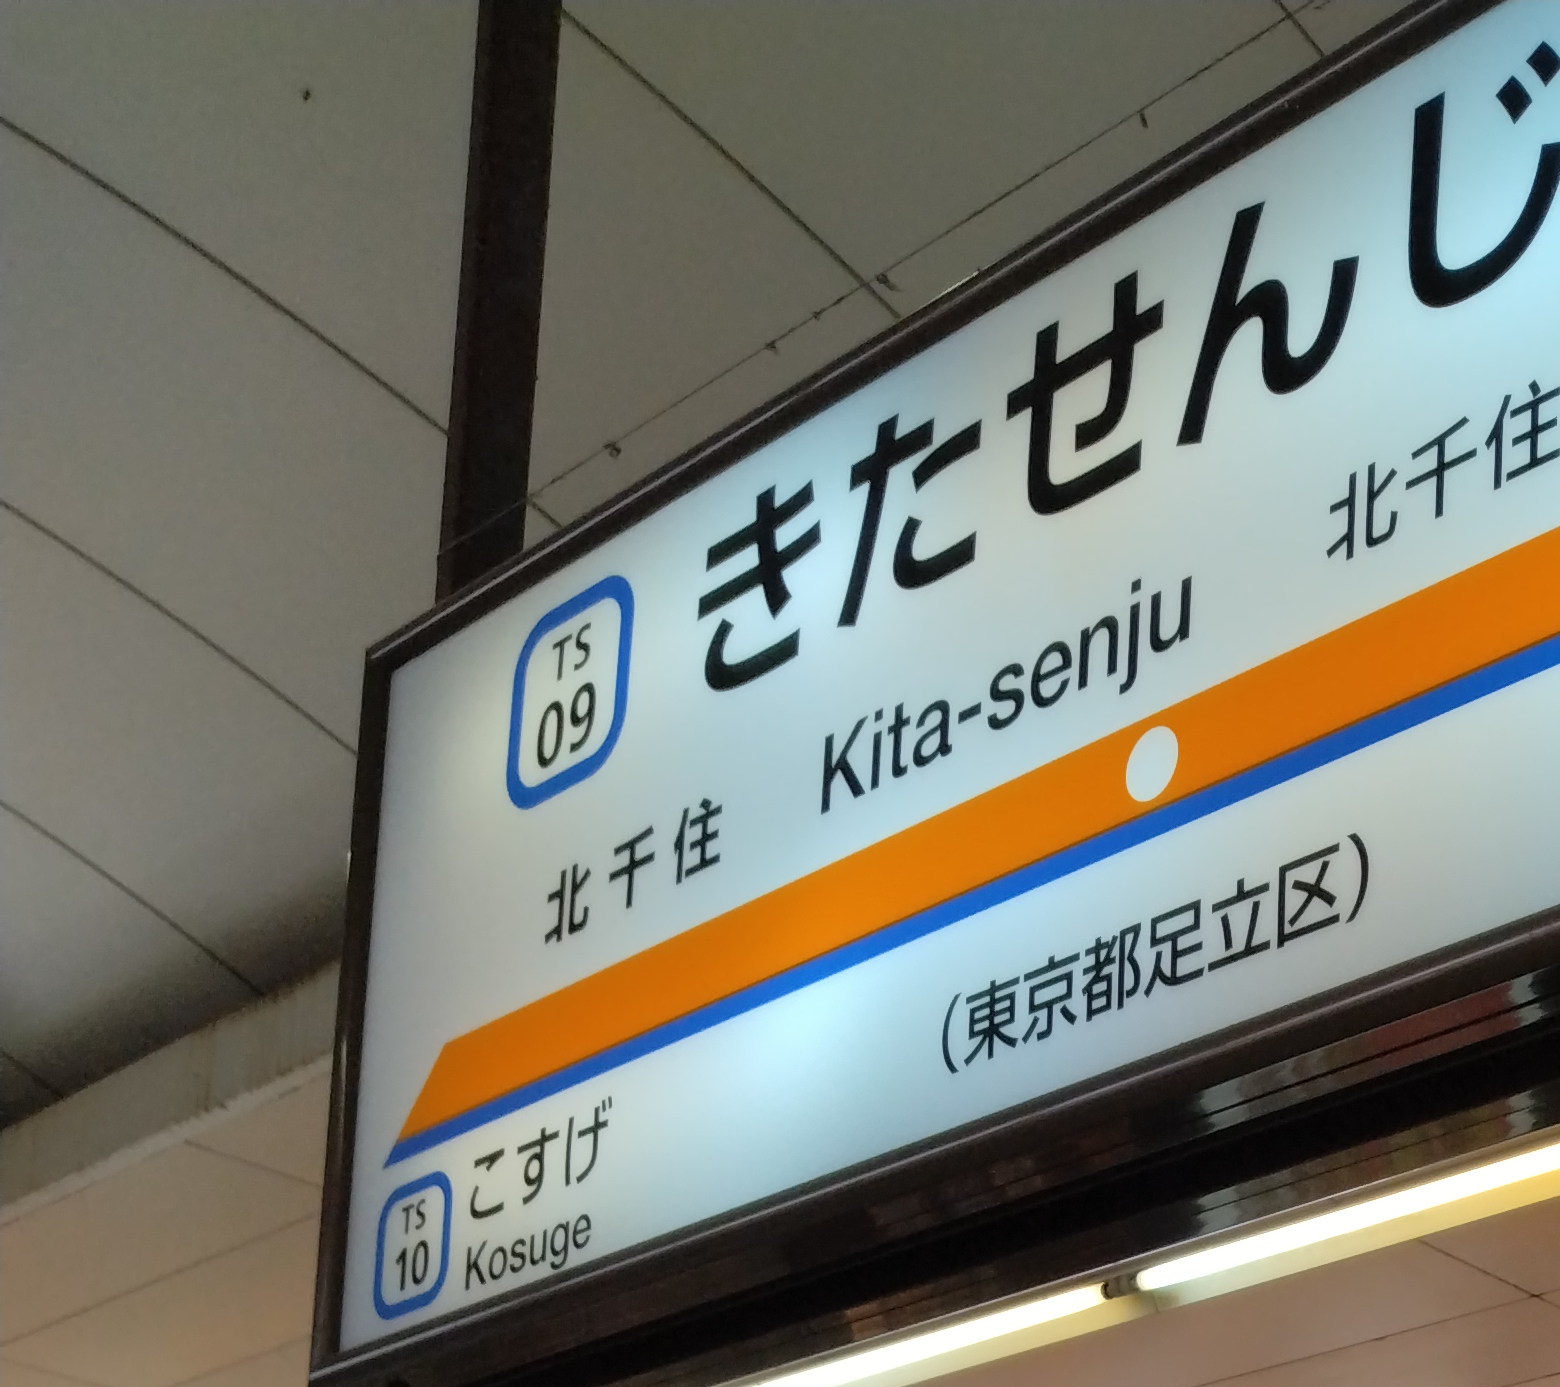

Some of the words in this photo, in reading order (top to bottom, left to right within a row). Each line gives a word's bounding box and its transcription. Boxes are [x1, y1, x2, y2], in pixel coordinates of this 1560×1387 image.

[1326, 378, 1560, 560] 北千住
[551, 623, 593, 683] TS
[820, 576, 1193, 812] Kita-senju
[536, 682, 598, 769] 09
[545, 797, 722, 942] 北千住
[941, 832, 1370, 1073] (東京都足立区)
[468, 1098, 612, 1219] こすげ
[395, 1243, 430, 1289] 10
[400, 1200, 426, 1229] TS
[464, 1209, 594, 1291] Kosuge
